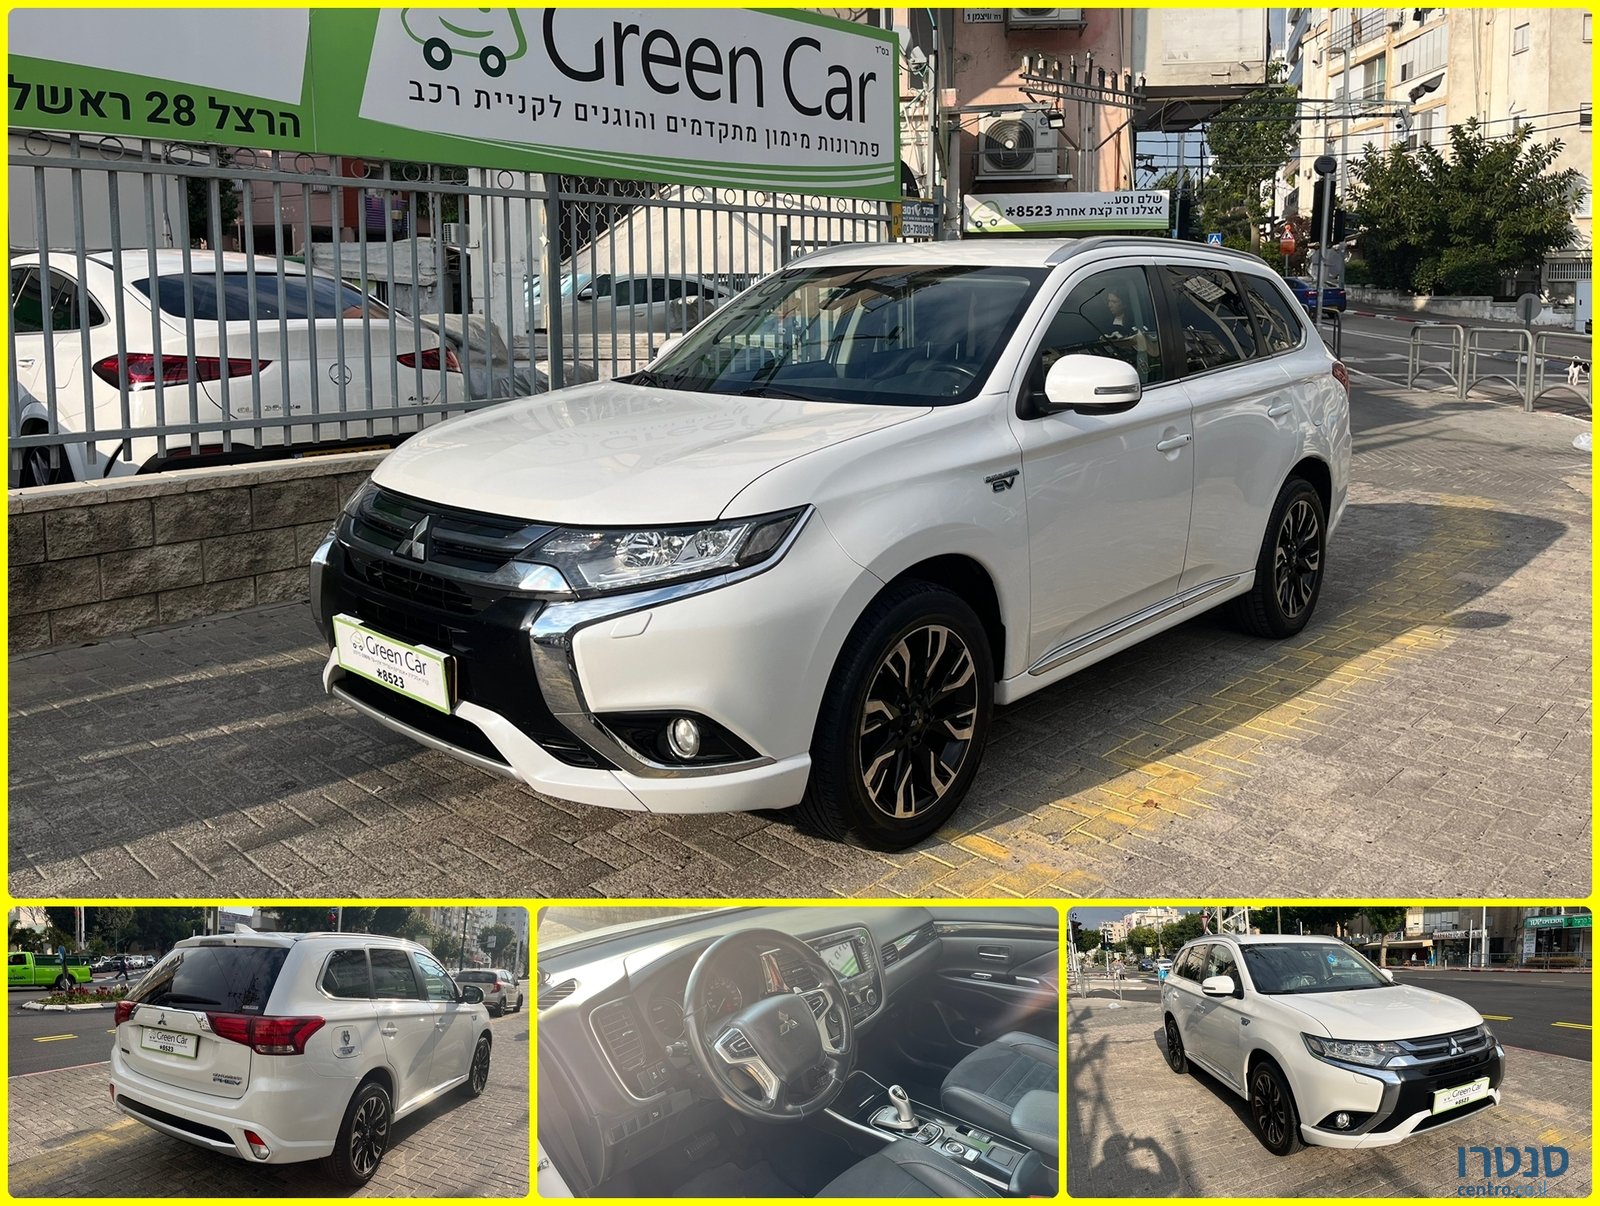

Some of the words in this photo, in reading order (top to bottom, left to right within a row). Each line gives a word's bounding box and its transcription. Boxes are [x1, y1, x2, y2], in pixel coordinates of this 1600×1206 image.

[542, 8, 764, 108] Green
[783, 36, 877, 123] Car
[408, 79, 460, 106] רכב
[145, 90, 196, 127] 28
[473, 88, 562, 122] לקניית
[574, 102, 656, 130] והוגנים
[208, 96, 301, 138] הרצל
[666, 115, 757, 144] מתקדמים
[765, 128, 811, 150] מימון
[817, 135, 880, 158] פתרונות
[1103, 195, 1134, 205] וסע...
[1131, 204, 1163, 215] אצלנו
[1137, 194, 1163, 204] שלם
[1055, 207, 1085, 217] אחרת
[1089, 207, 1112, 218] קצת
[1115, 206, 1128, 216] זה
[992, 476, 1015, 492] EV
[365, 635, 403, 667] Green
[404, 650, 427, 676] Car
[156, 1031, 176, 1042] Green
[176, 1034, 188, 1045] Car
[1451, 1086, 1472, 1099] Green
[1472, 1082, 1482, 1093] Car
